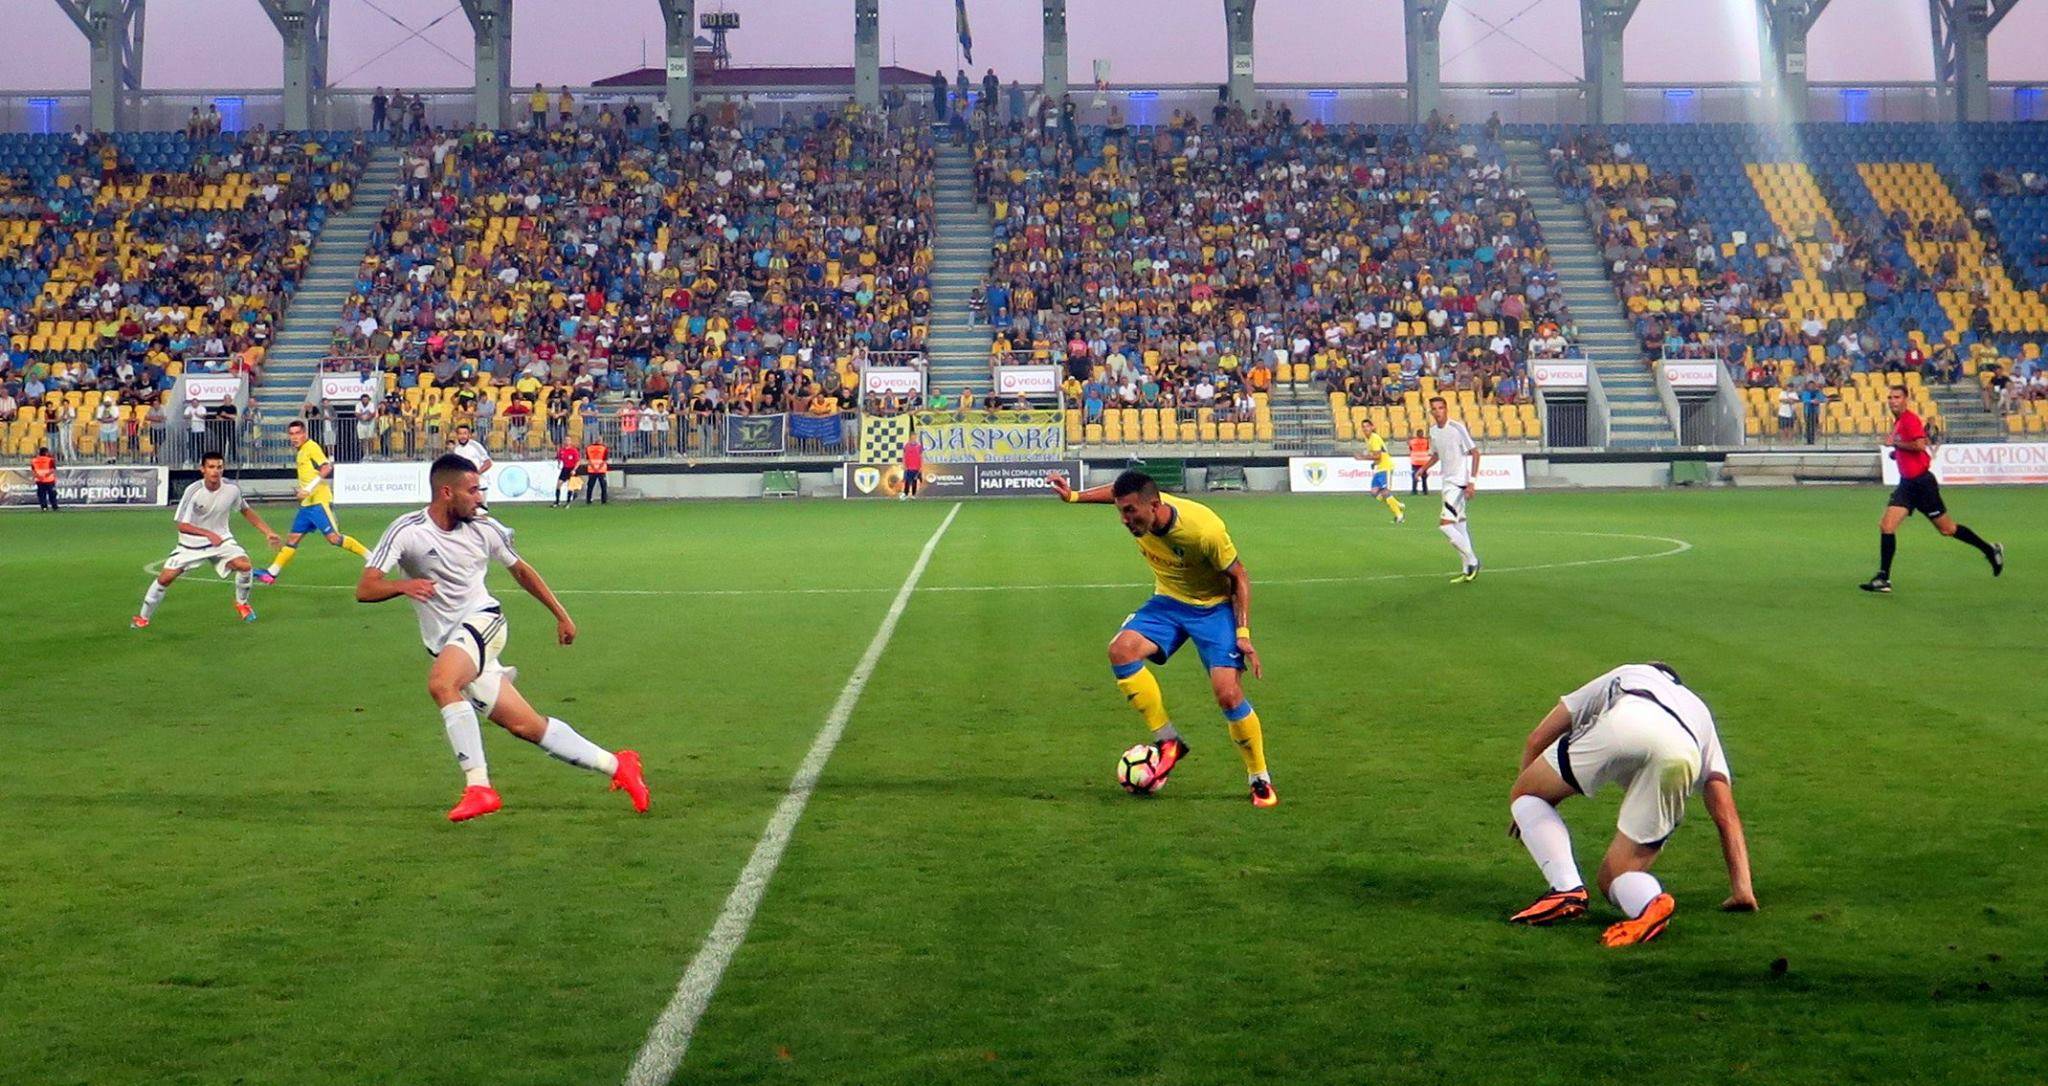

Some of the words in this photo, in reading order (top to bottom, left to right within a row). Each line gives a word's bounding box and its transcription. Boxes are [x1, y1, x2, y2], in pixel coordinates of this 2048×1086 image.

[701, 13, 739, 28] HOTEL
[1551, 371, 1584, 379] VEOLIA
[1680, 371, 1714, 379] VEOLIA
[1018, 378, 1052, 386] VEOLIA
[1945, 446, 2047, 465] CAMPION
[937, 474, 964, 482] VEOLIA
[981, 478, 1003, 489] HAI
[56, 487, 78, 499] HAI
[80, 486, 147, 498] PETROLUL!
